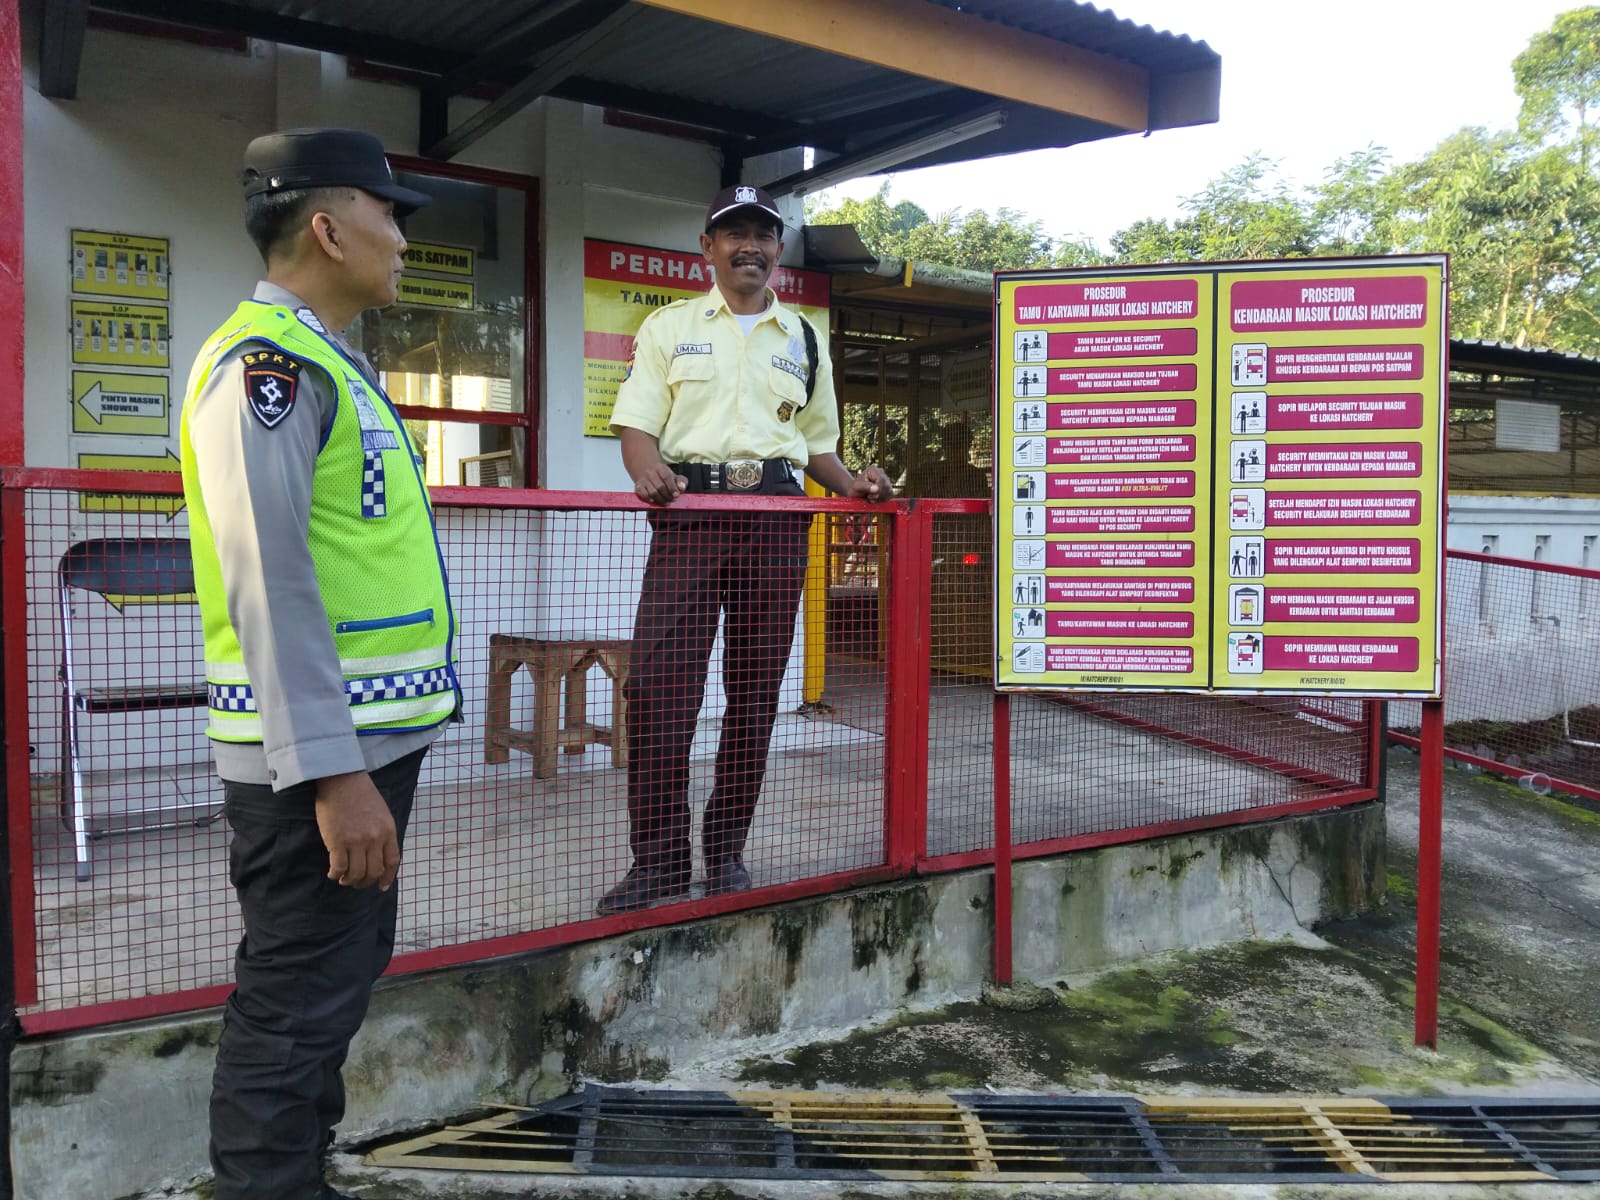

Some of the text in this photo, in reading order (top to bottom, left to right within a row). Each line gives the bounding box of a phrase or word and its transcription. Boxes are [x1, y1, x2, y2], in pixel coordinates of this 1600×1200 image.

[425, 251, 468, 268] SATPAM
[611, 251, 716, 283] PERHAT
[620, 290, 672, 306] TAMU
[1084, 287, 1126, 300] PROSEDUR
[1302, 287, 1355, 302] PROSEDUR
[1019, 301, 1193, 319] TAMU / KARYAWAN MASUK LOKASI HATCHERY
[1234, 304, 1423, 324] KENDARAAN MASUK LOKASI HATCHERY
[244, 353, 298, 369] SPKT
[1275, 352, 1412, 362] SOPIR MENGHENTIKAN KENDARAAN DIJALAN
[1276, 366, 1301, 374] KHUSUS
[1302, 365, 1339, 373] KENDARAAN
[1350, 364, 1370, 372] DEPAN
[1372, 364, 1385, 372] POS
[1386, 363, 1412, 371] SATPAM
[129, 396, 159, 404] MASUK
[101, 404, 138, 412] SHOWER
[1278, 402, 1406, 412] SOPIR MELAPOR SECURITY TUJUAN MASUK
[1320, 414, 1340, 422] LOKASI
[1341, 656, 1373, 664] HATCHERY
